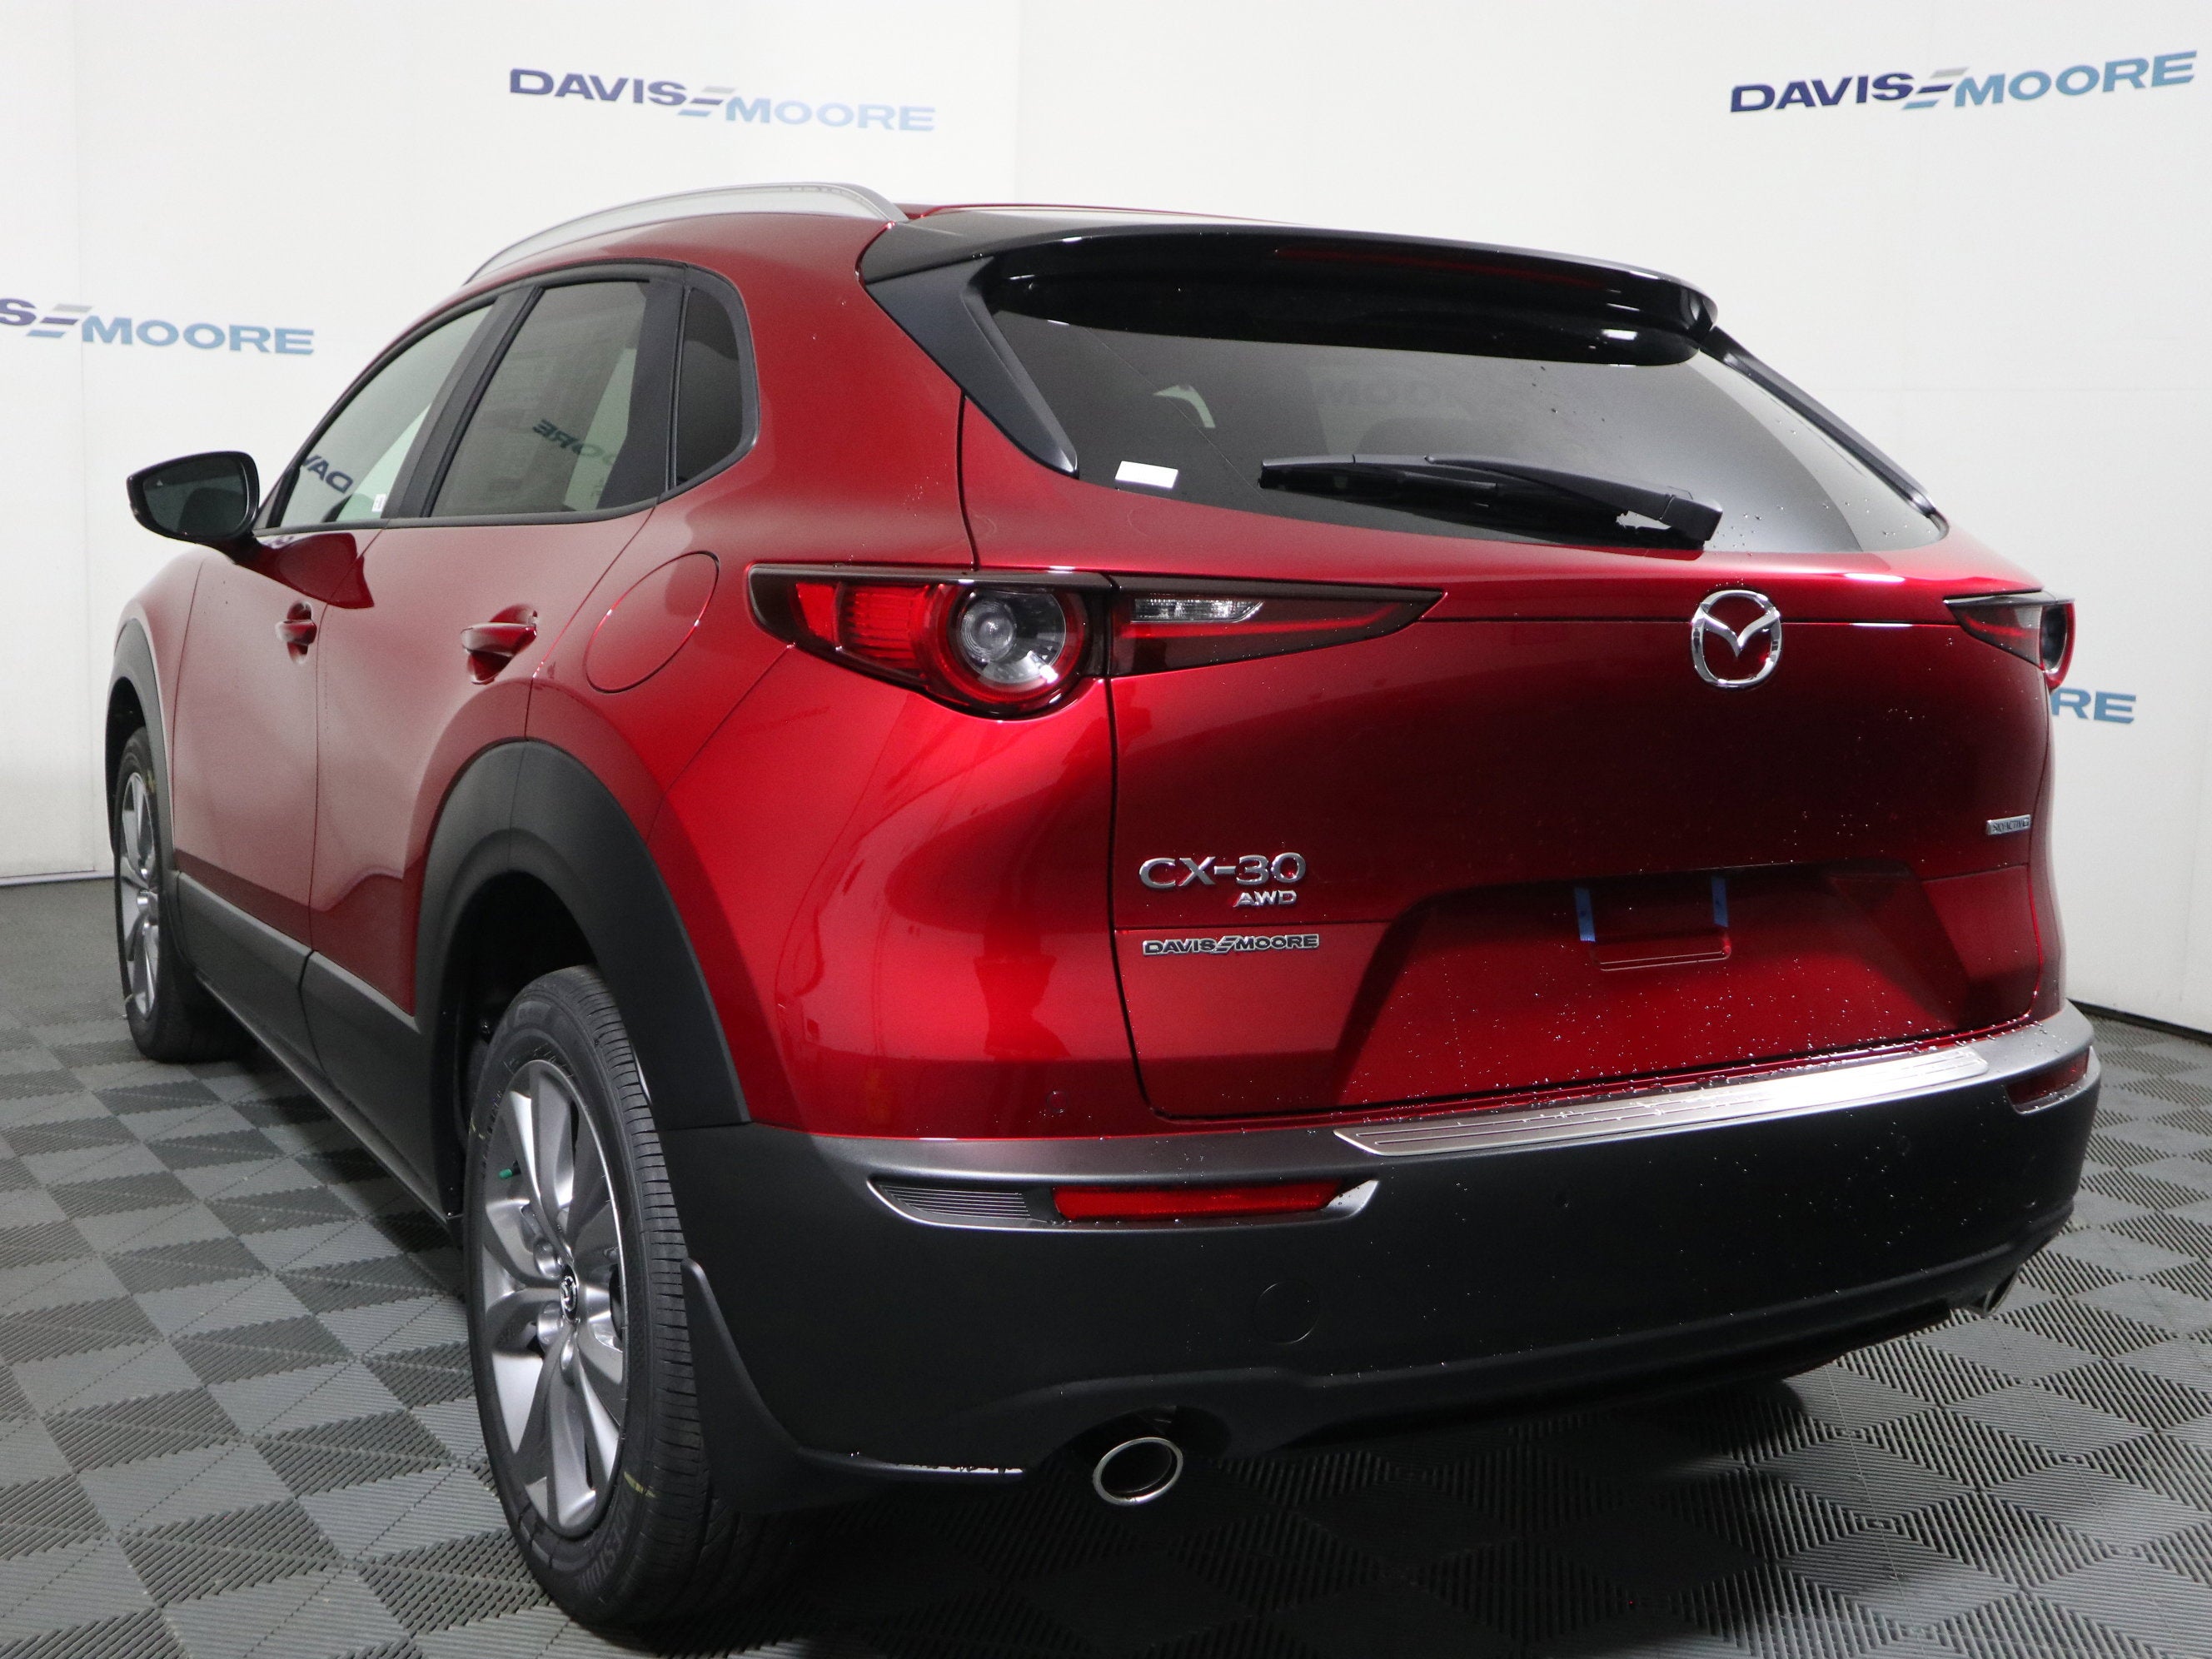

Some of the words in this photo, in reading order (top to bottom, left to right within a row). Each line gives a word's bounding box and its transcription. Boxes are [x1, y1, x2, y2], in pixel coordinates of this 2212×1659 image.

[510, 67, 687, 106] DAVIS
[725, 96, 937, 132] MOORE
[1730, 72, 1916, 112] DAVIS
[1953, 50, 2198, 108] MOORE
[82, 315, 315, 355] MOORE
[1138, 852, 1306, 889] CX-30
[1233, 889, 1298, 908] AWD
[1143, 936, 1216, 955] DAVIS
[1234, 934, 1320, 951] MOORE
